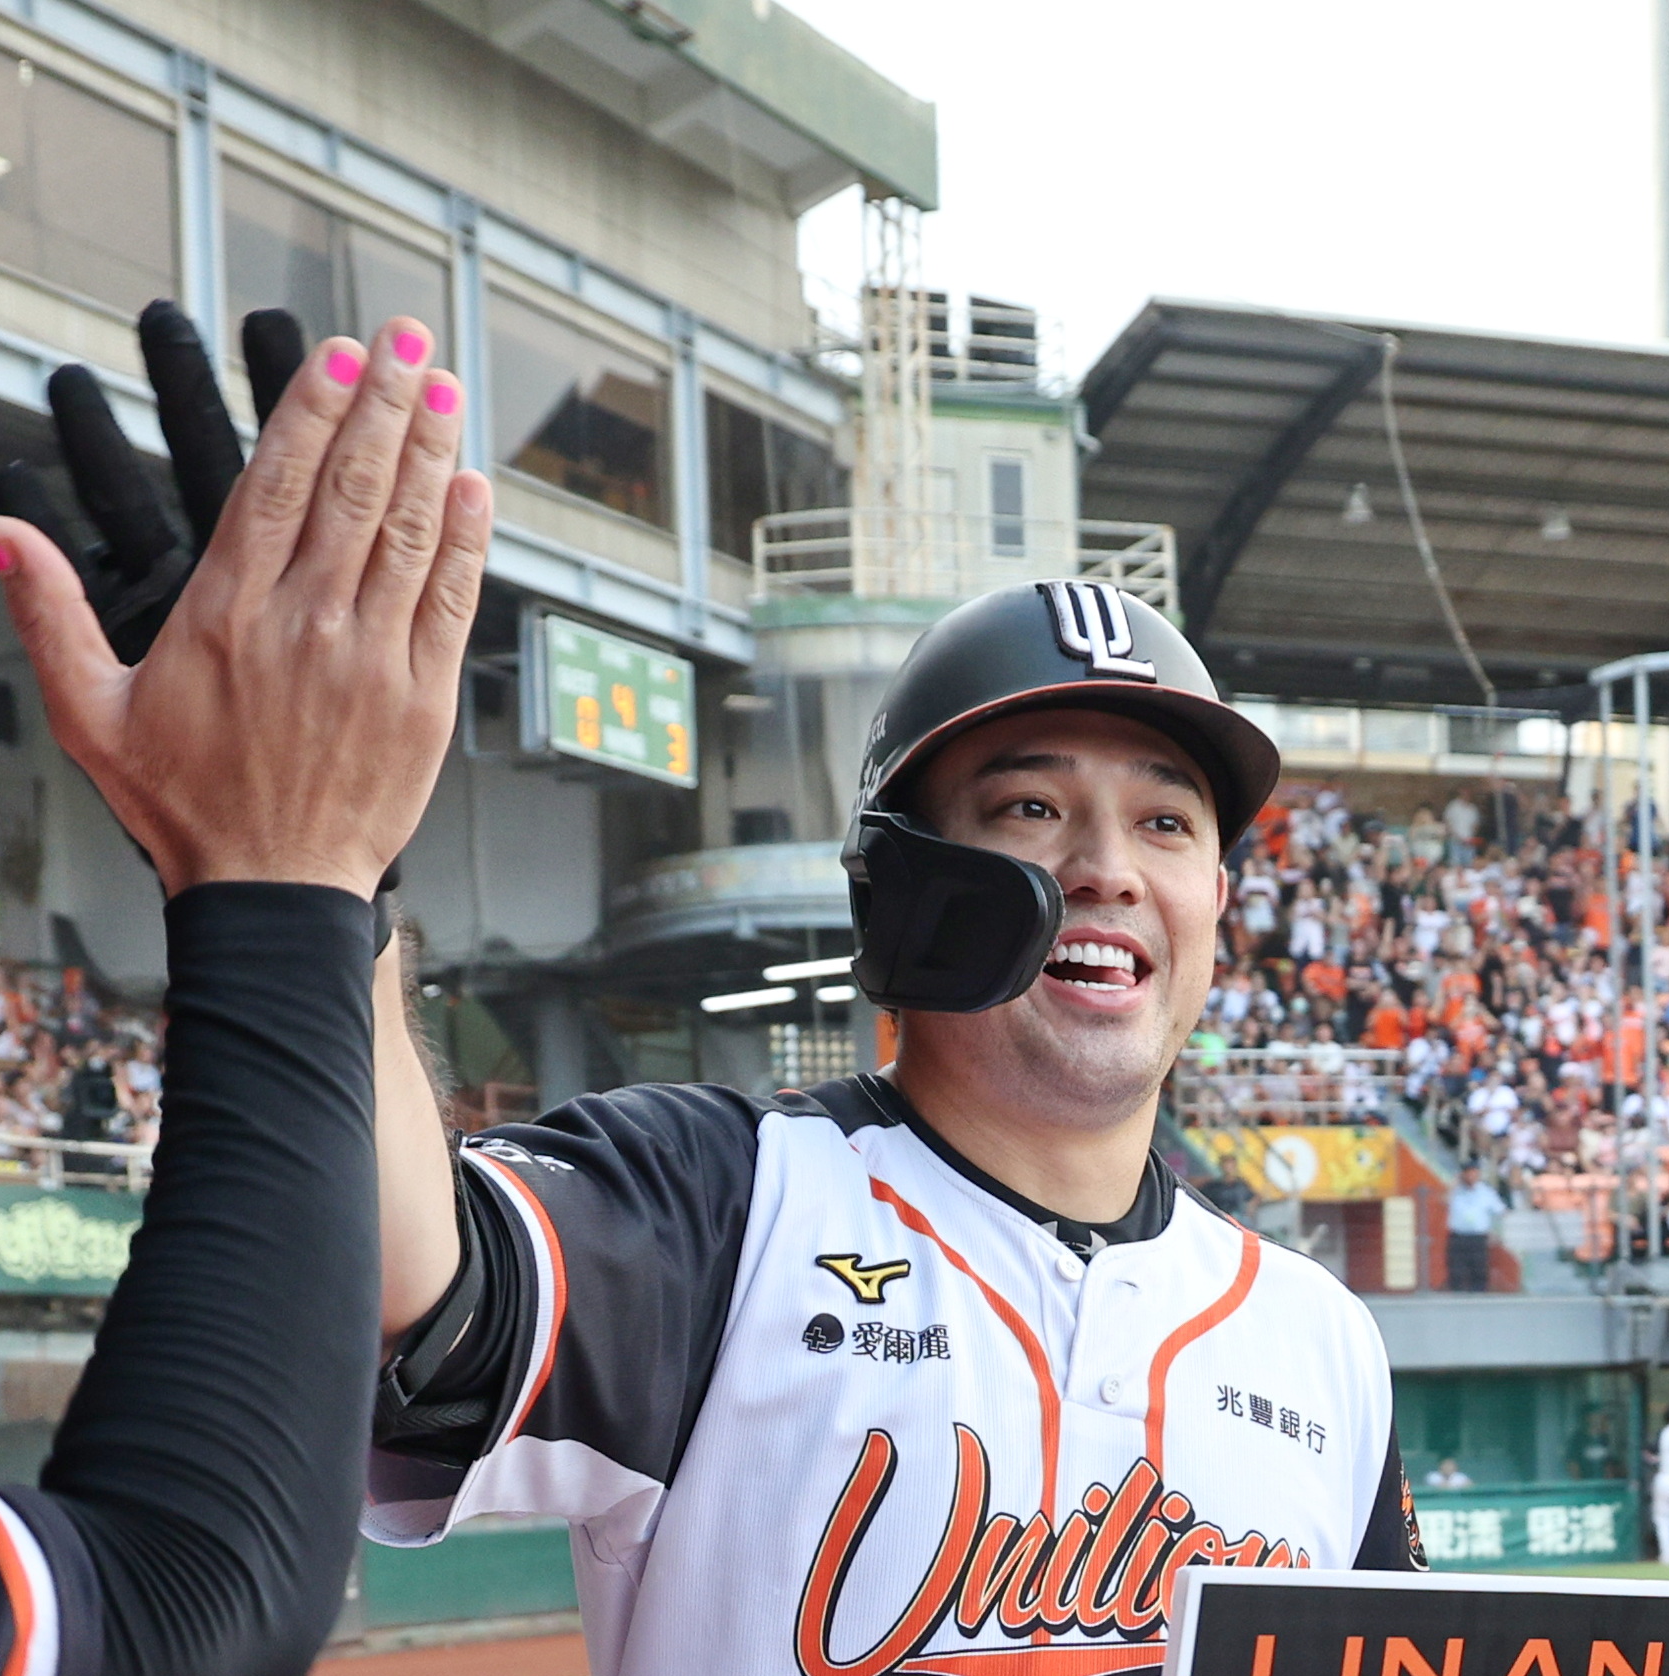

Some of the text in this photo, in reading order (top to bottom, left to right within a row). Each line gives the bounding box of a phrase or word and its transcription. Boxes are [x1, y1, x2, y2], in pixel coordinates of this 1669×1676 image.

[851, 1321, 951, 1364] 愛爾麗
[1216, 1384, 1326, 1454] 兆豐銀行
